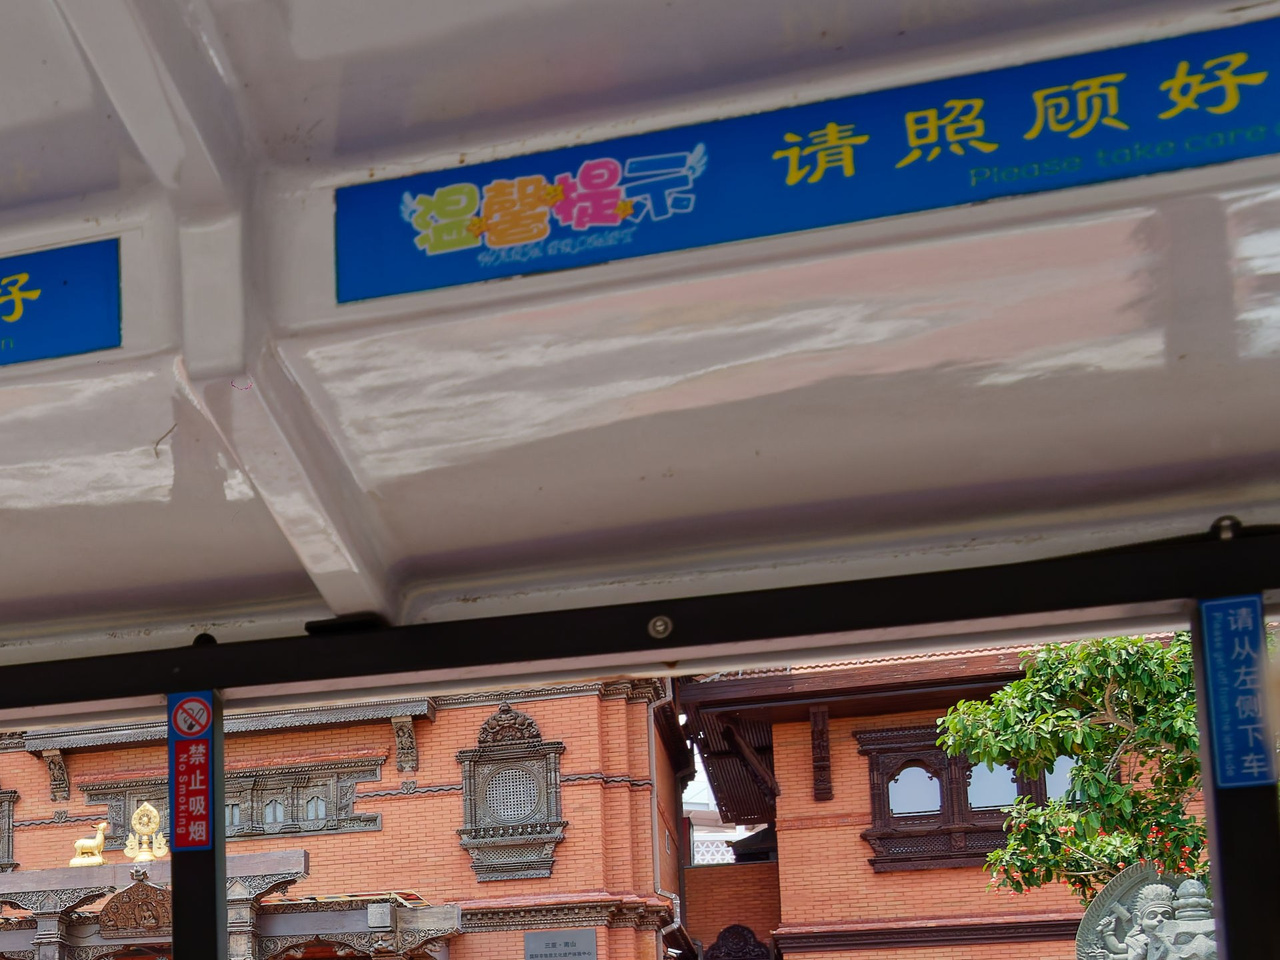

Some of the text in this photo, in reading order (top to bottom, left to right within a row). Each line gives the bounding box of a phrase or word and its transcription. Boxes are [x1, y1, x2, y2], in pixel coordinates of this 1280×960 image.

[771, 52, 1269, 186] 请照顾好
[969, 155, 1083, 186] Please
[1096, 140, 1175, 167] take
[1184, 125, 1267, 152] care
[1227, 607, 1269, 777] 请从左侧下车
[177, 754, 188, 834] No Smoking
[188, 744, 207, 842] 禁止吸烟
